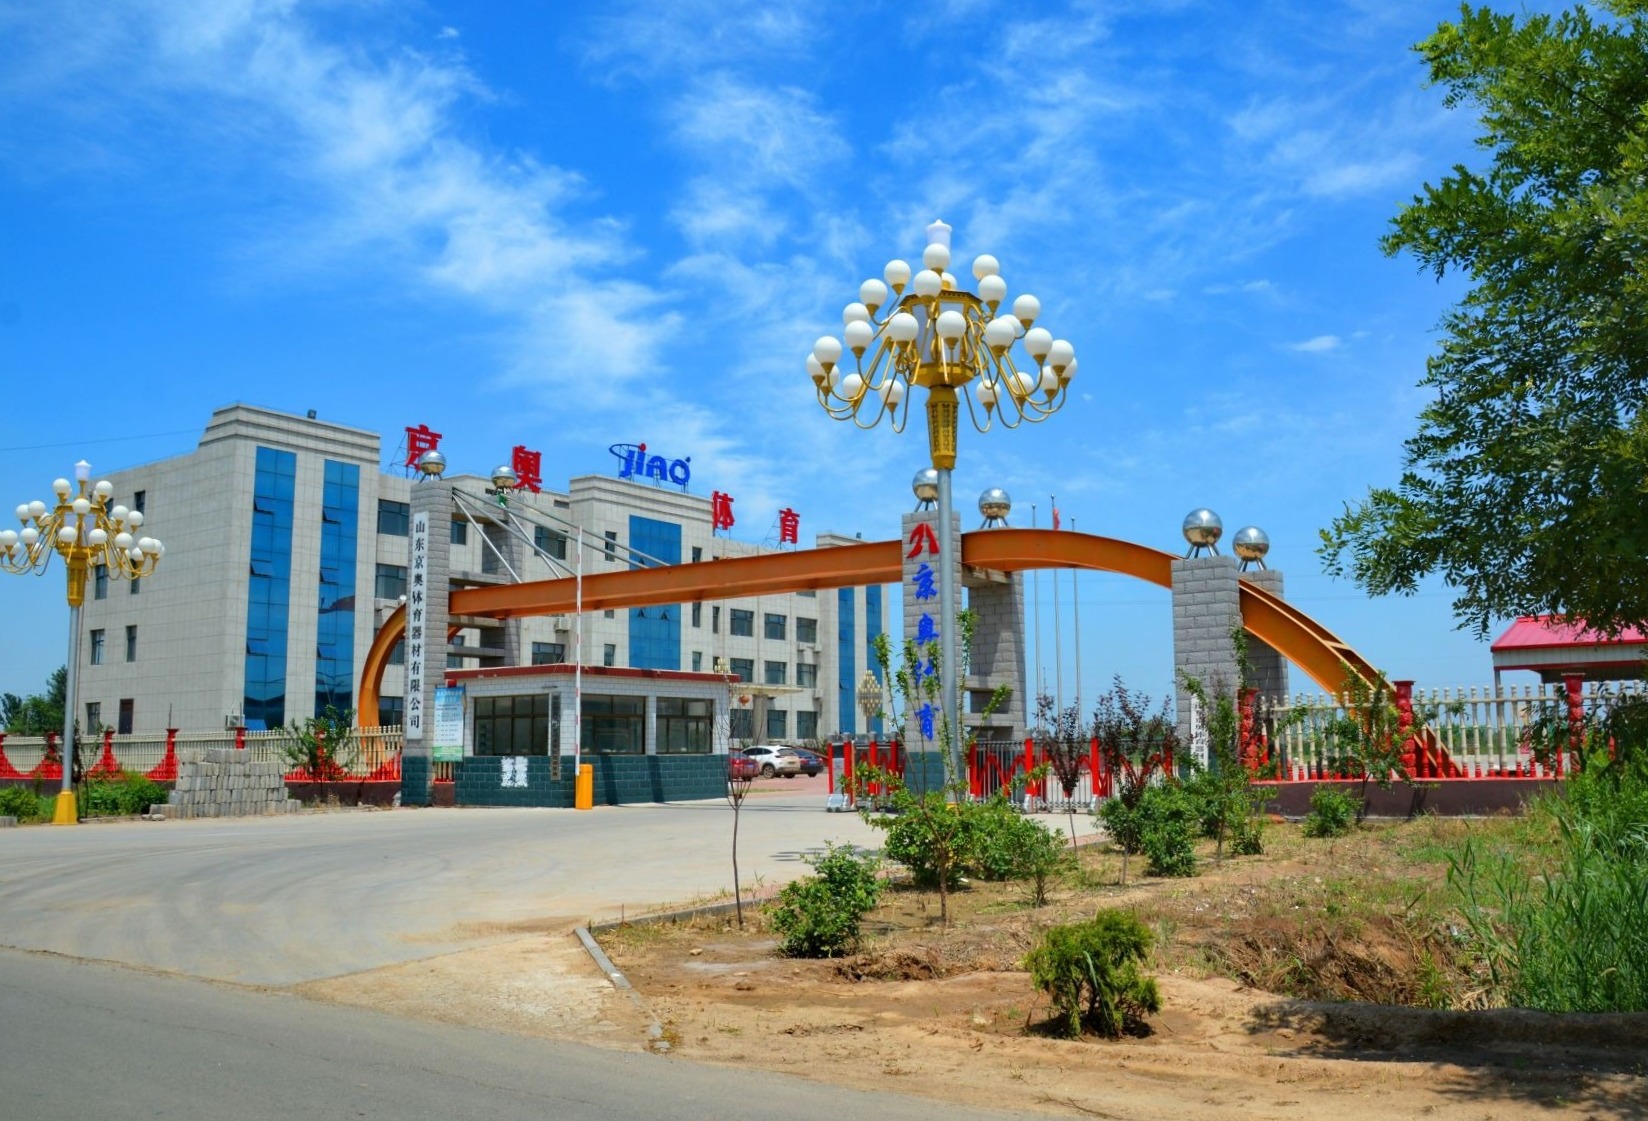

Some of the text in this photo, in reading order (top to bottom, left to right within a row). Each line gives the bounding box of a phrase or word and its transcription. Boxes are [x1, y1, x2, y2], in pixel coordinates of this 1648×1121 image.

[409, 520, 426, 729] 山东京奥体育器材有限公司
